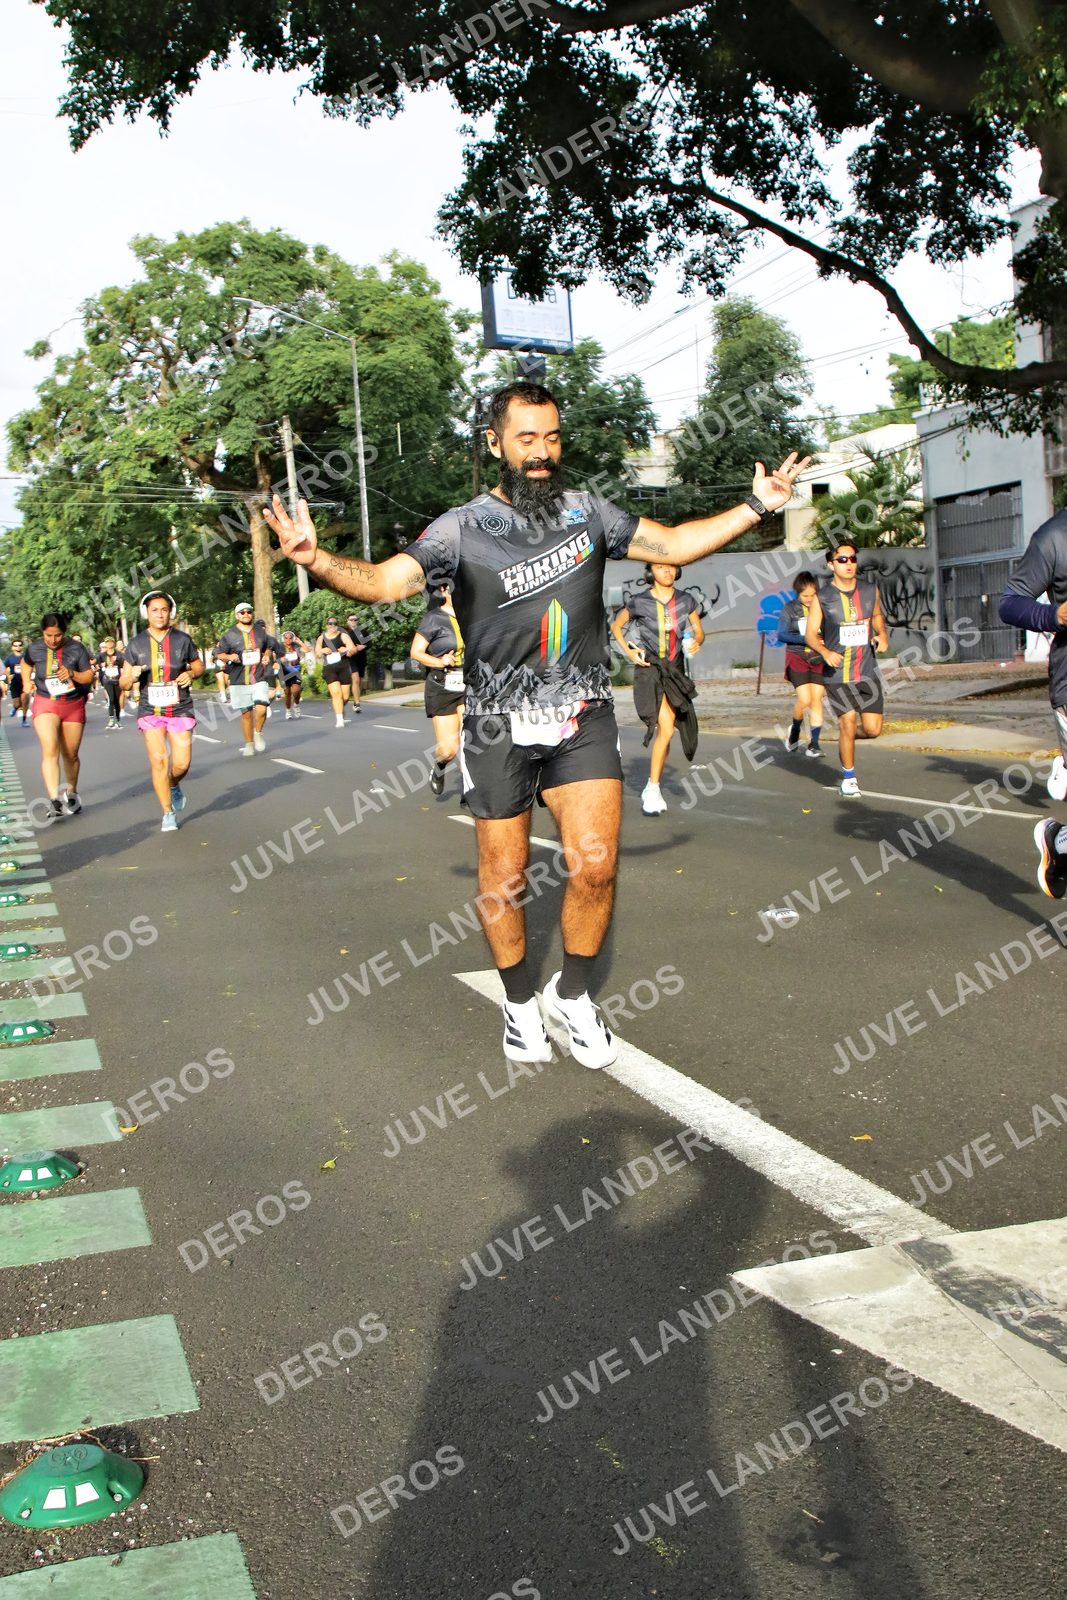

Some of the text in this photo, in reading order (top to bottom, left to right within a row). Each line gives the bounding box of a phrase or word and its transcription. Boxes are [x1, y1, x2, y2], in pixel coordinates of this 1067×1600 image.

[498, 562, 526, 580] THE
[504, 530, 590, 593] HIKING
[509, 556, 575, 598] RUNNERS
